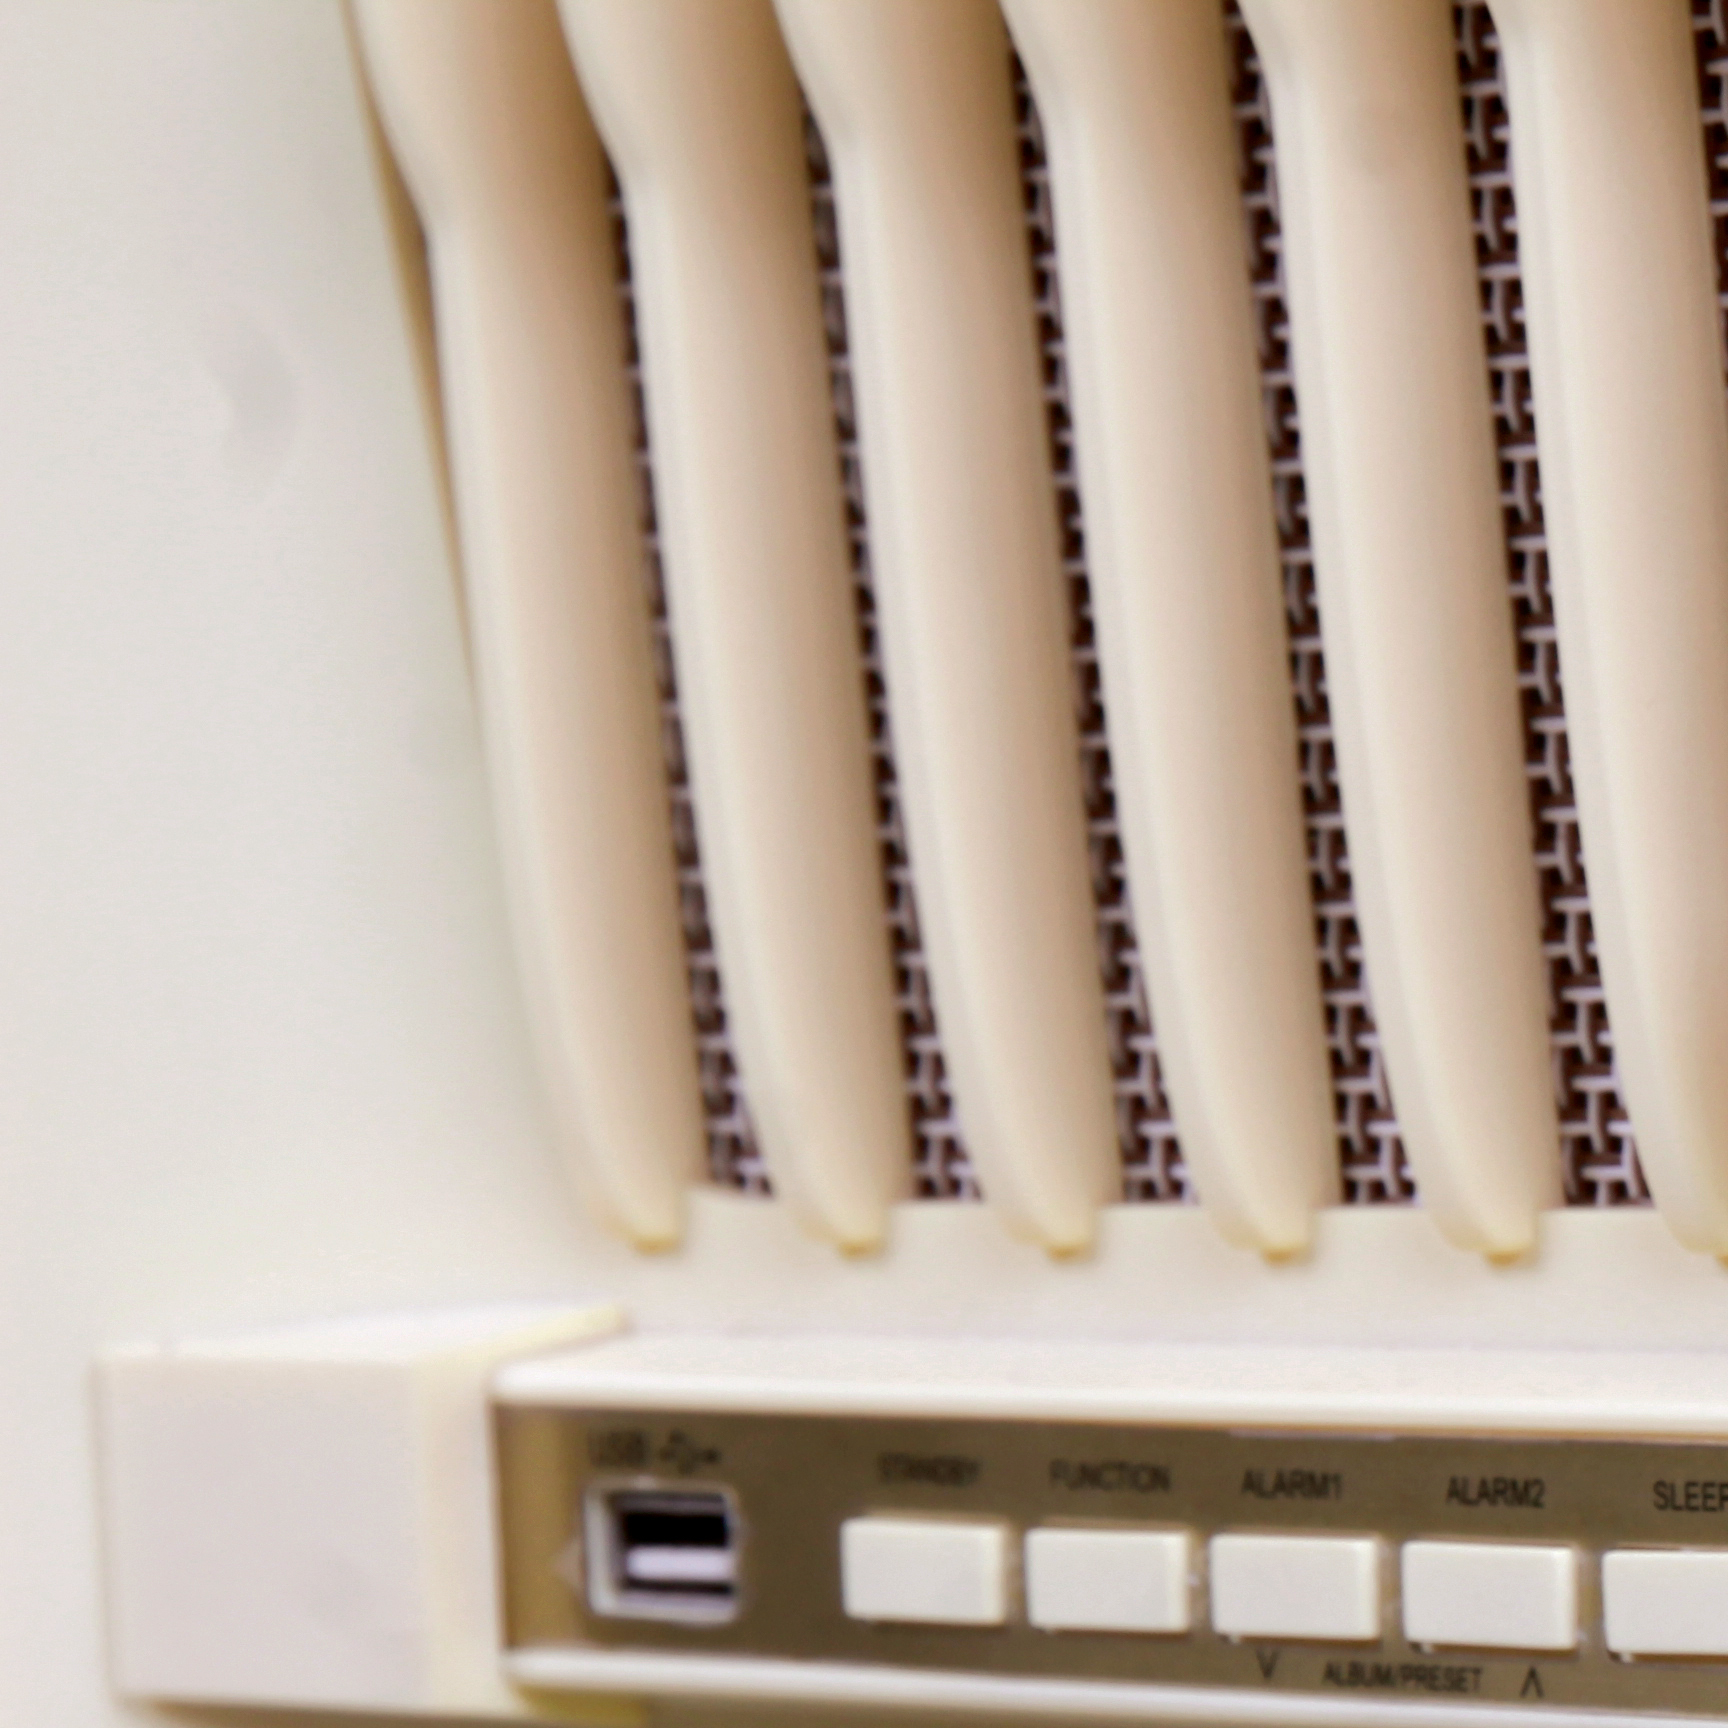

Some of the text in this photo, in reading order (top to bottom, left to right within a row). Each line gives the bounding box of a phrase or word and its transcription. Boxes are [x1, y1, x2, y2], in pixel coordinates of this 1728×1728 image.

[1049, 1459, 1172, 1494] FUNCTION
[1241, 1467, 1344, 1501] ALARM1
[1446, 1476, 1547, 1510] ALARM2
[1322, 1661, 1484, 1695] ALBUM/PRESET
